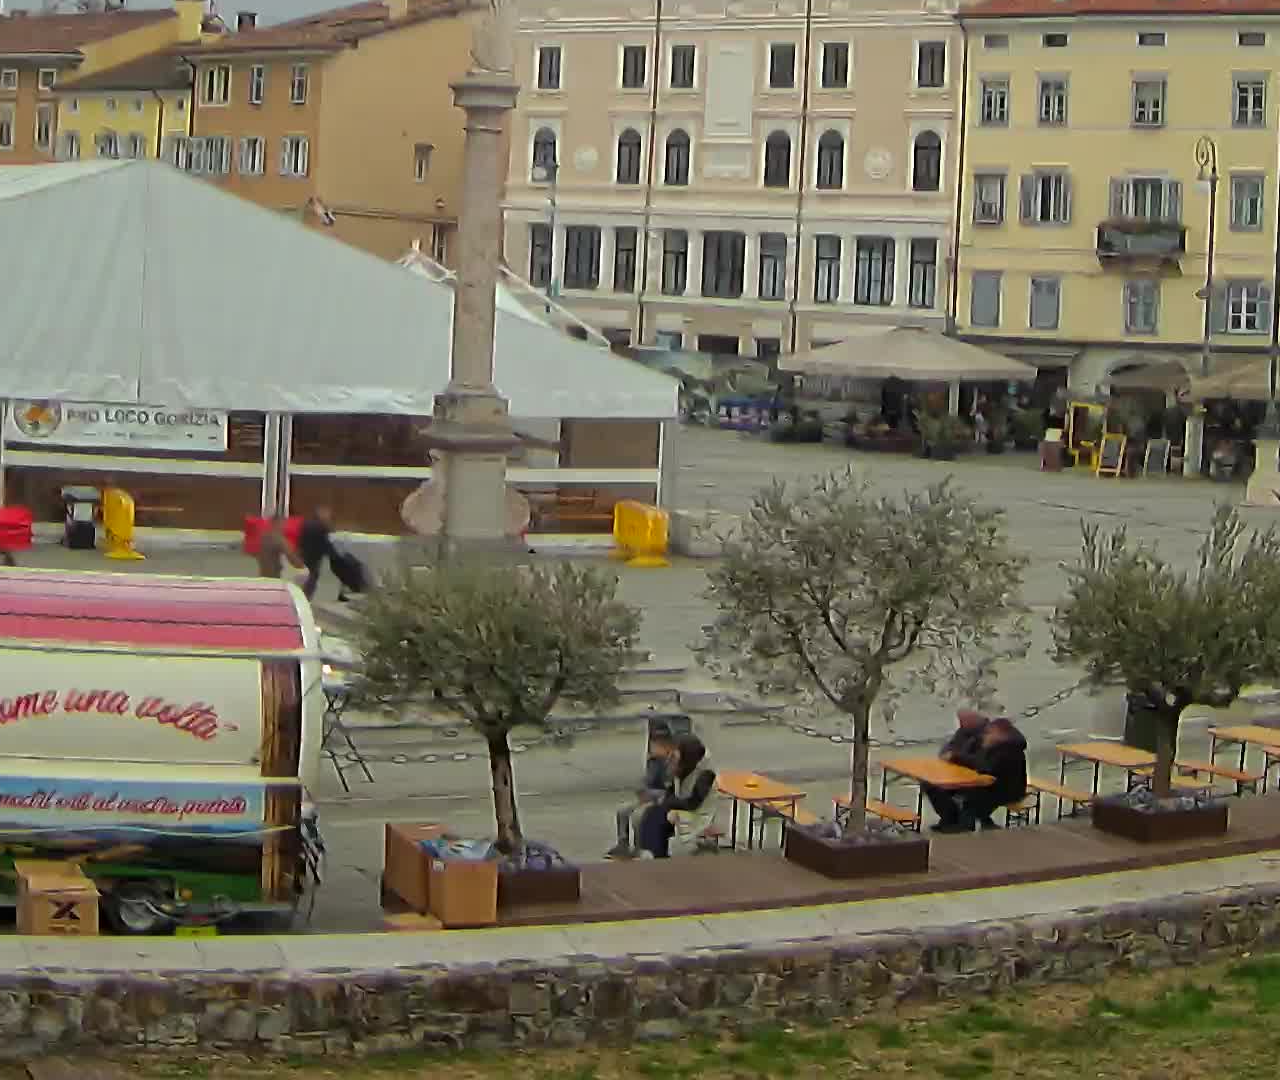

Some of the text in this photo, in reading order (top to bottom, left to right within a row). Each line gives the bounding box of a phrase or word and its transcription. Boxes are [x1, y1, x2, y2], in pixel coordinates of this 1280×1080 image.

[104, 409, 149, 425] LOCO
[153, 409, 221, 427] GORIZIA
[63, 687, 130, 716] una
